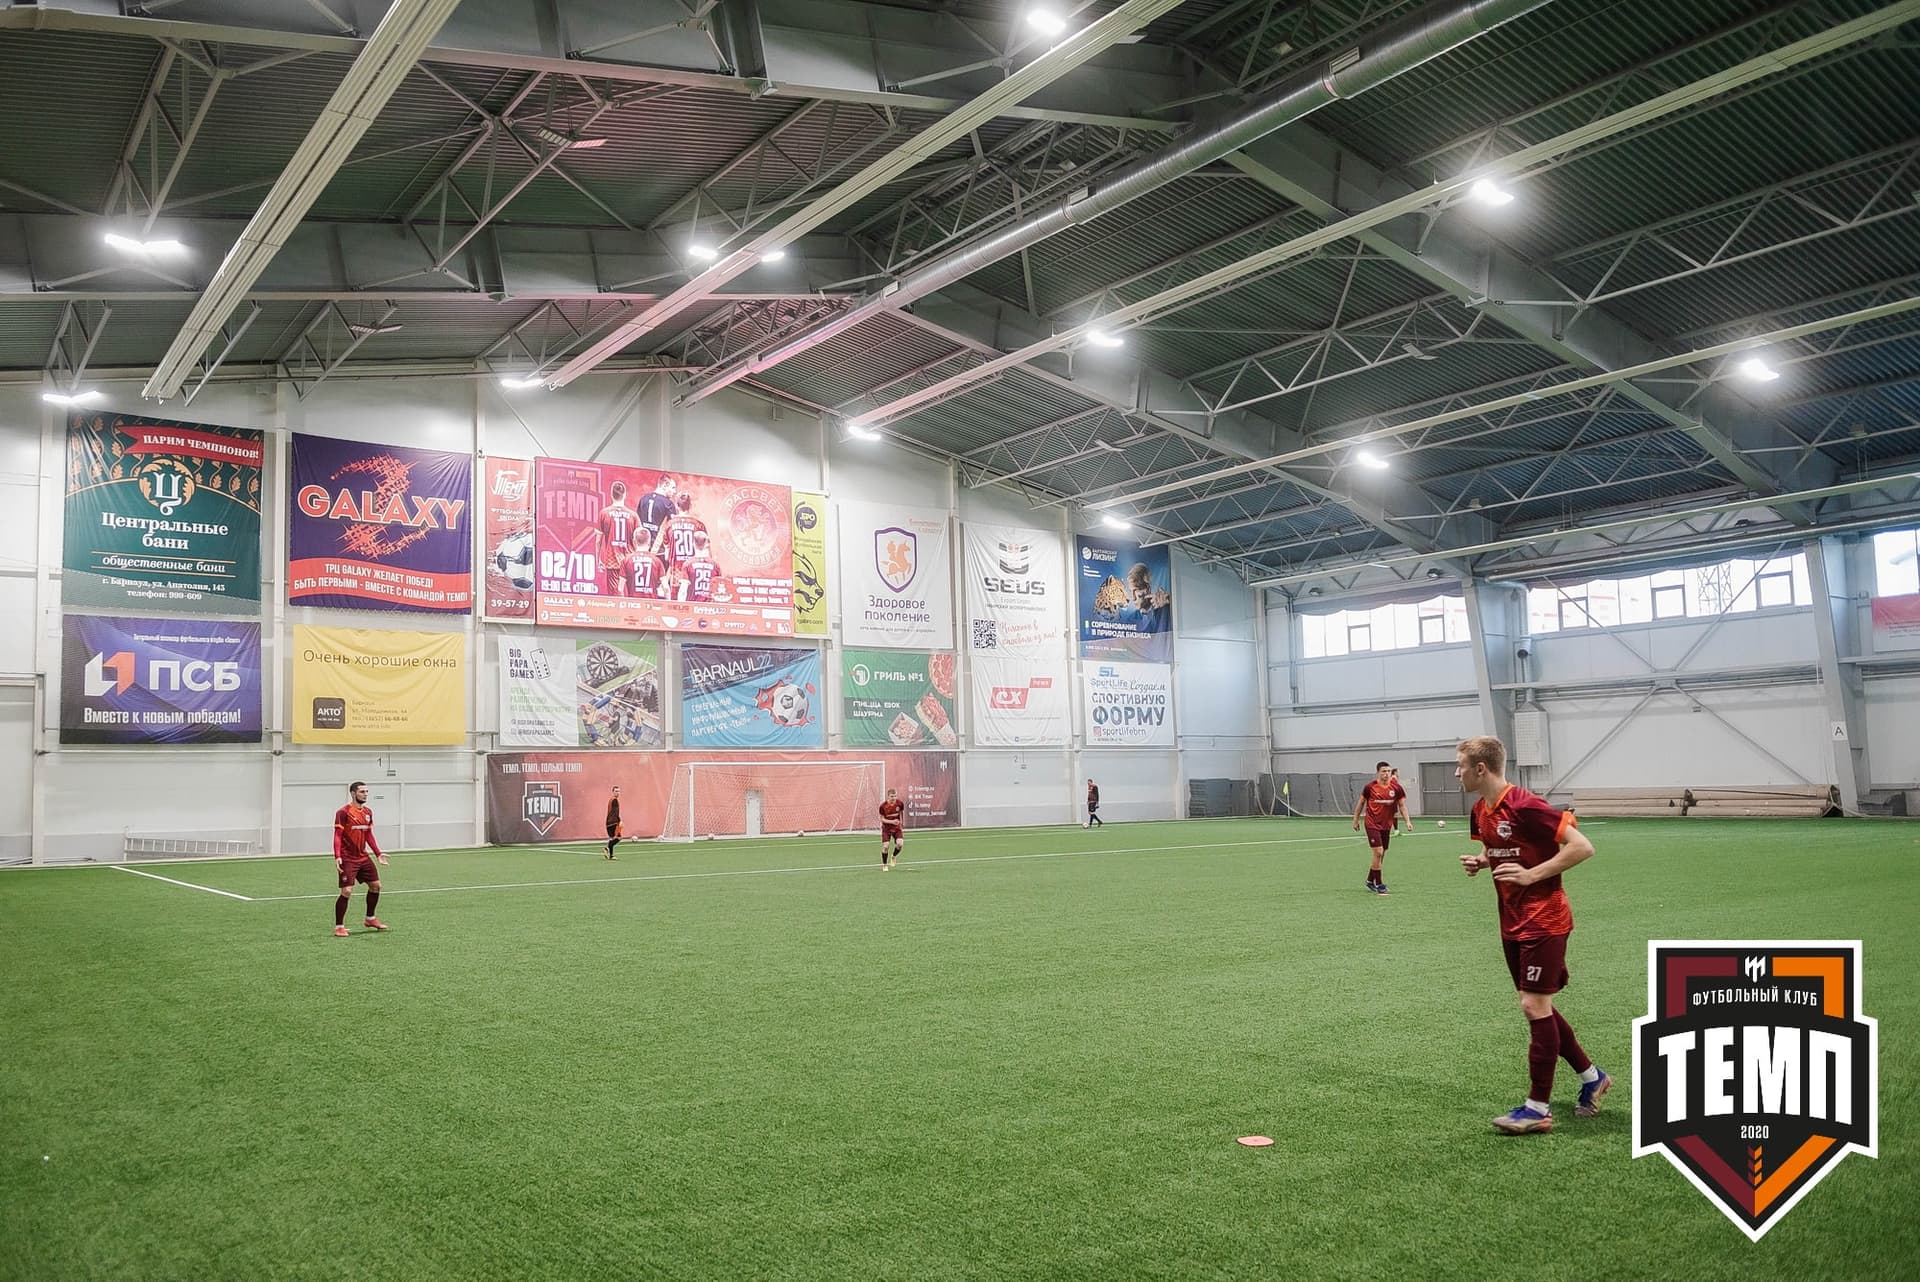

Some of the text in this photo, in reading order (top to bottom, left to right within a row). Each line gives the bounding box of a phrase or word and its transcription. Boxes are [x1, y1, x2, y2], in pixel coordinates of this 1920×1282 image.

[143, 435, 259, 459] ПАРИМ ЧЕМПИОНОВ!
[297, 484, 465, 530] GALAXY
[543, 490, 599, 524] ТЕМП
[101, 512, 229, 536] Центральные
[613, 517, 626, 541] 11
[142, 533, 189, 550] бани
[673, 529, 695, 556] 20
[102, 555, 226, 573] общественные бани
[324, 563, 341, 574] ТРЦ
[342, 564, 373, 578] GALAXY
[373, 569, 405, 583] ЖЕЛАЕТ
[540, 550, 596, 581] 02/10
[634, 561, 652, 588] 27
[127, 590, 168, 599] телефон:
[294, 579, 317, 590] БЫТЬ
[318, 577, 358, 589] ПЕРВЫМИ
[364, 582, 395, 595] ВМЕСТЕ
[396, 586, 402, 596] С
[402, 587, 445, 601] КОМАНДОЙ
[983, 577, 1046, 596] SEUS
[490, 599, 530, 609] 39-57-29
[868, 594, 926, 610] Здоровое
[864, 610, 930, 623] поколение
[1091, 620, 1137, 631] СОРЕВНОВАНИЕ
[303, 649, 457, 668] Очень хорошие окна
[509, 648, 522, 658] BIG
[509, 658, 529, 669] PAPA
[149, 660, 241, 692] ПСБ
[509, 669, 535, 680] GAMES
[873, 671, 906, 681] ГРИЛЬ
[1091, 692, 1166, 705] СПОРТИВНУЮ
[84, 707, 241, 725] Вместе к новым победам!
[317, 707, 341, 716] АКТО
[853, 710, 884, 718] ШАУРМА
[1092, 705, 1165, 726] ФОРМУ
[502, 763, 521, 774] ТЕМП,
[521, 762, 540, 773] ТЕМП,
[541, 762, 565, 773] ТОЛЬКО
[526, 796, 559, 815] ТЕМП
[1526, 965, 1543, 982] 27
